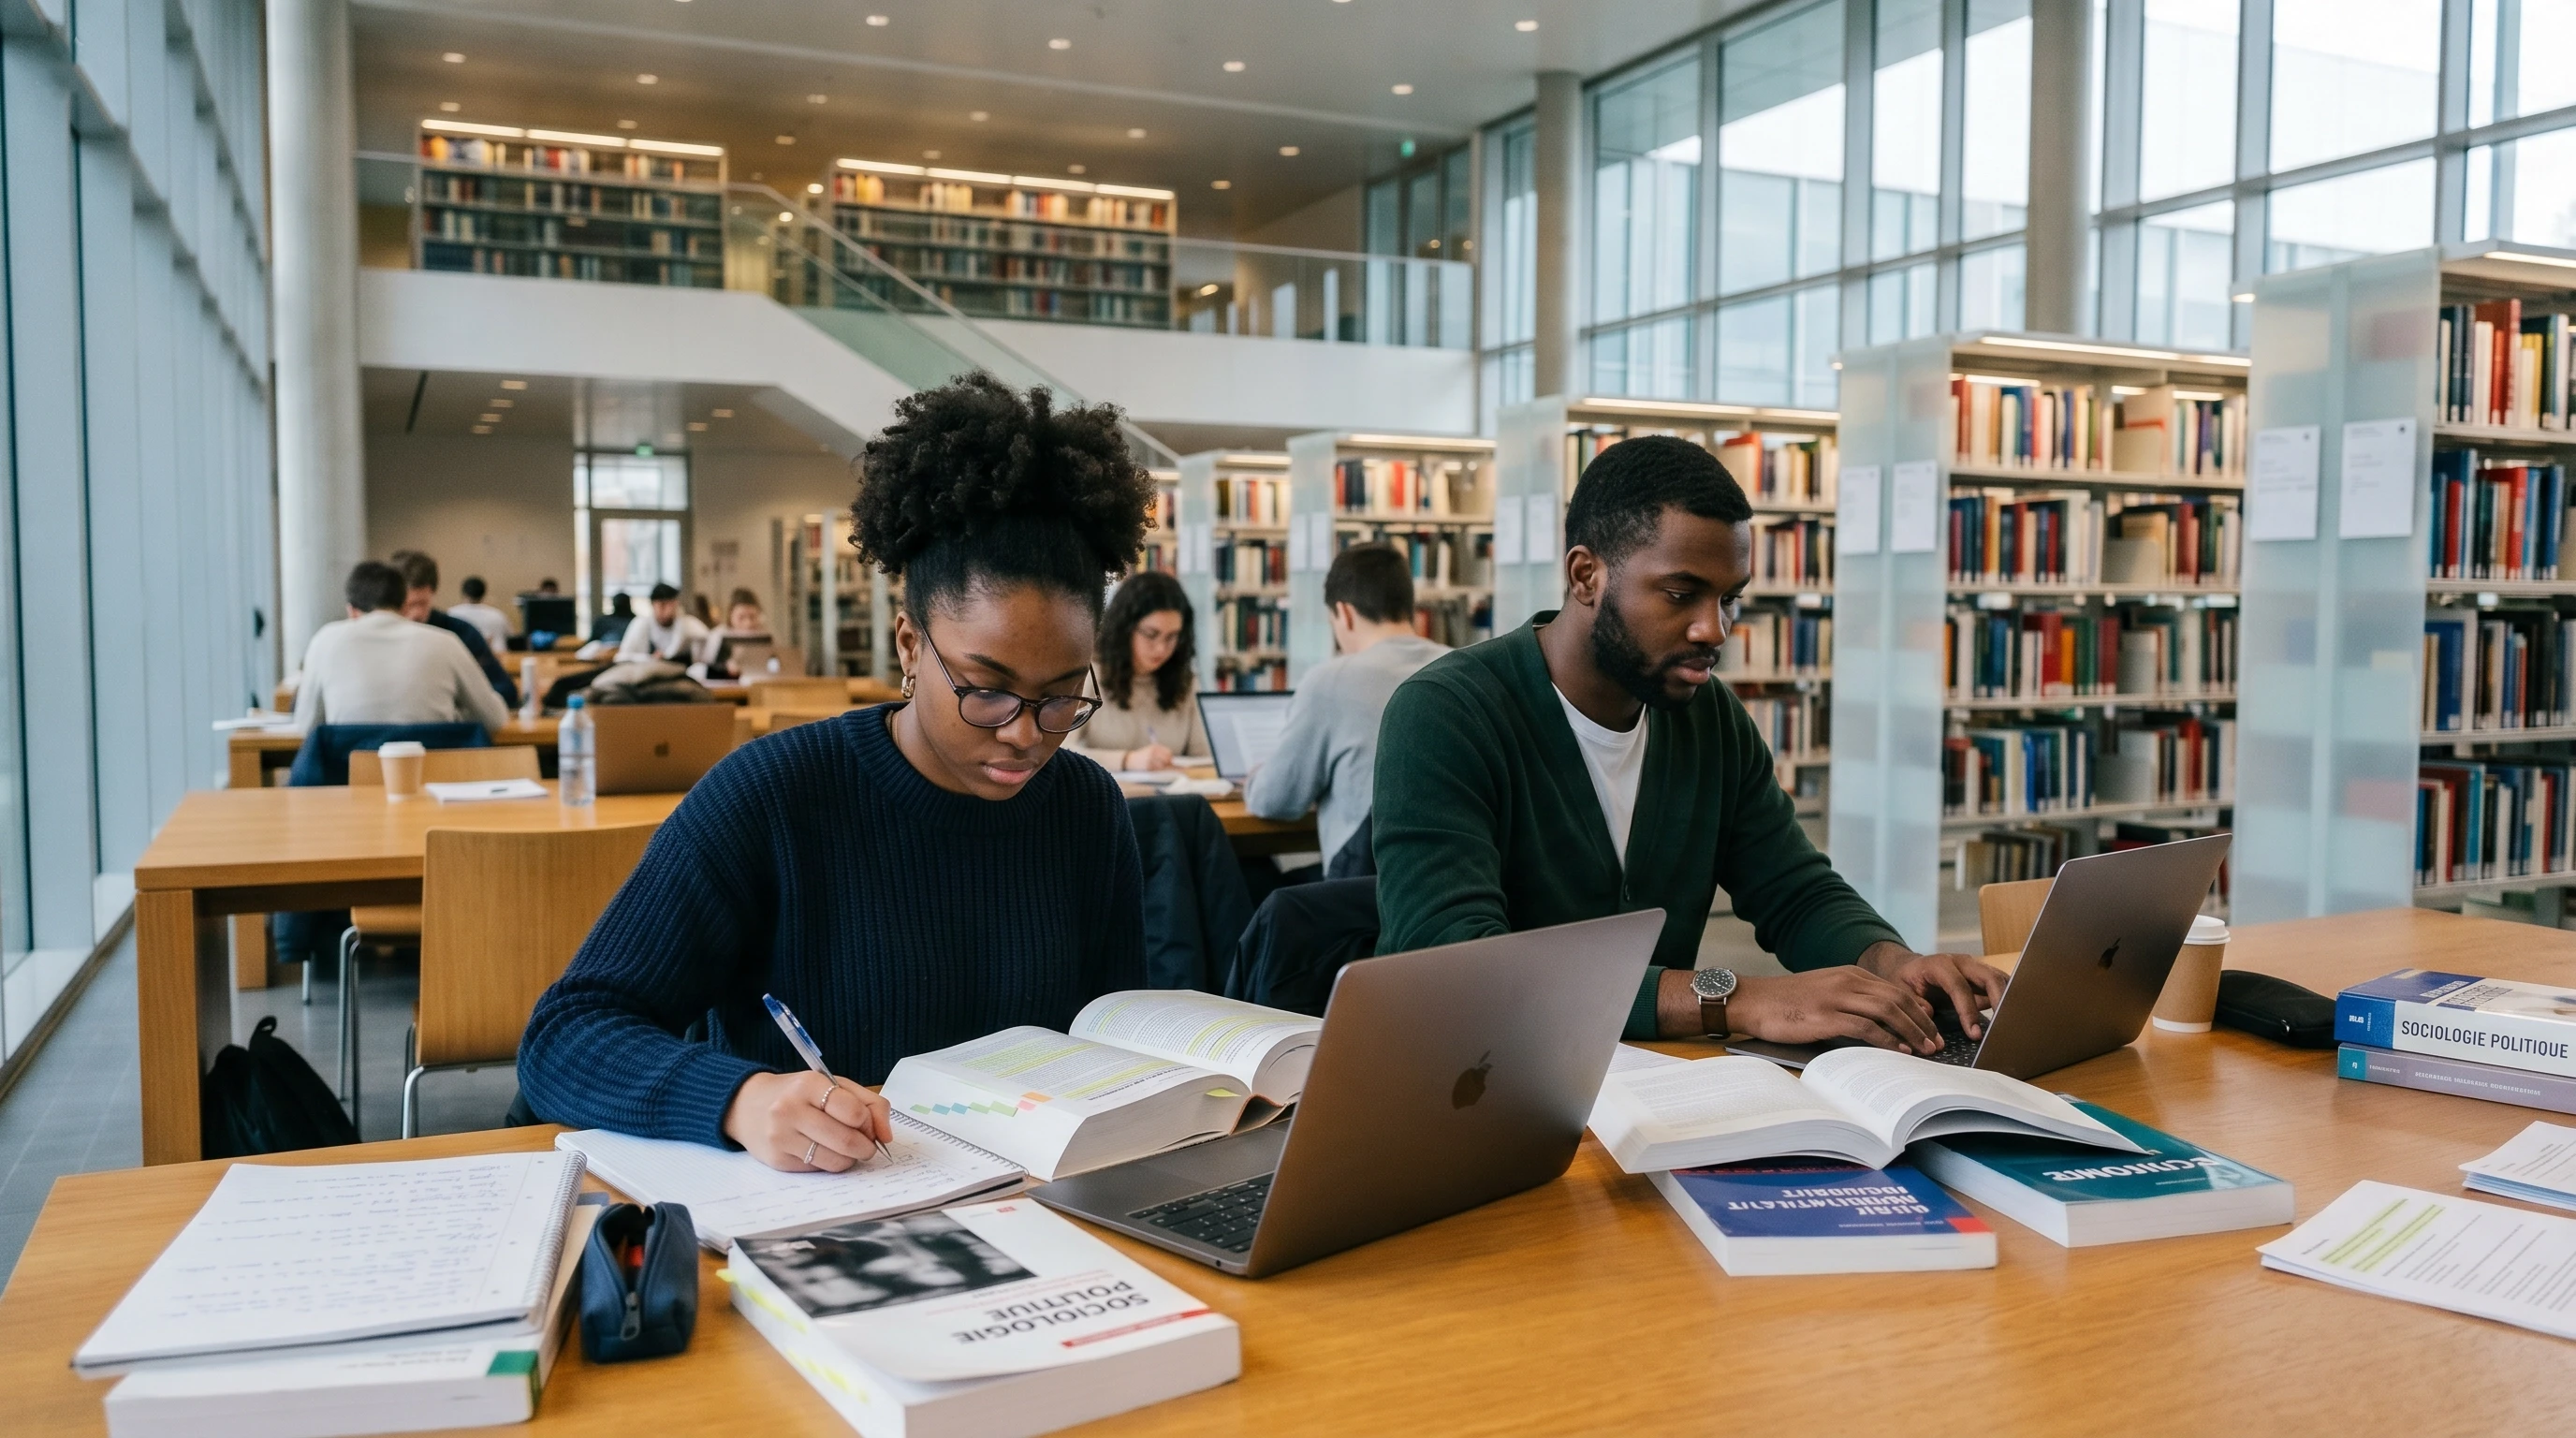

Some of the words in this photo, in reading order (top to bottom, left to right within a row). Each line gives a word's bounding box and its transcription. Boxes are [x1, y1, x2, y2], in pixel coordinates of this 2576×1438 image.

[2401, 1020, 2487, 1048] SOCIOLOGIE
[2490, 1034, 2569, 1059] POLITIQUE
[952, 1292, 1150, 1344] SOCIOLOGIE
